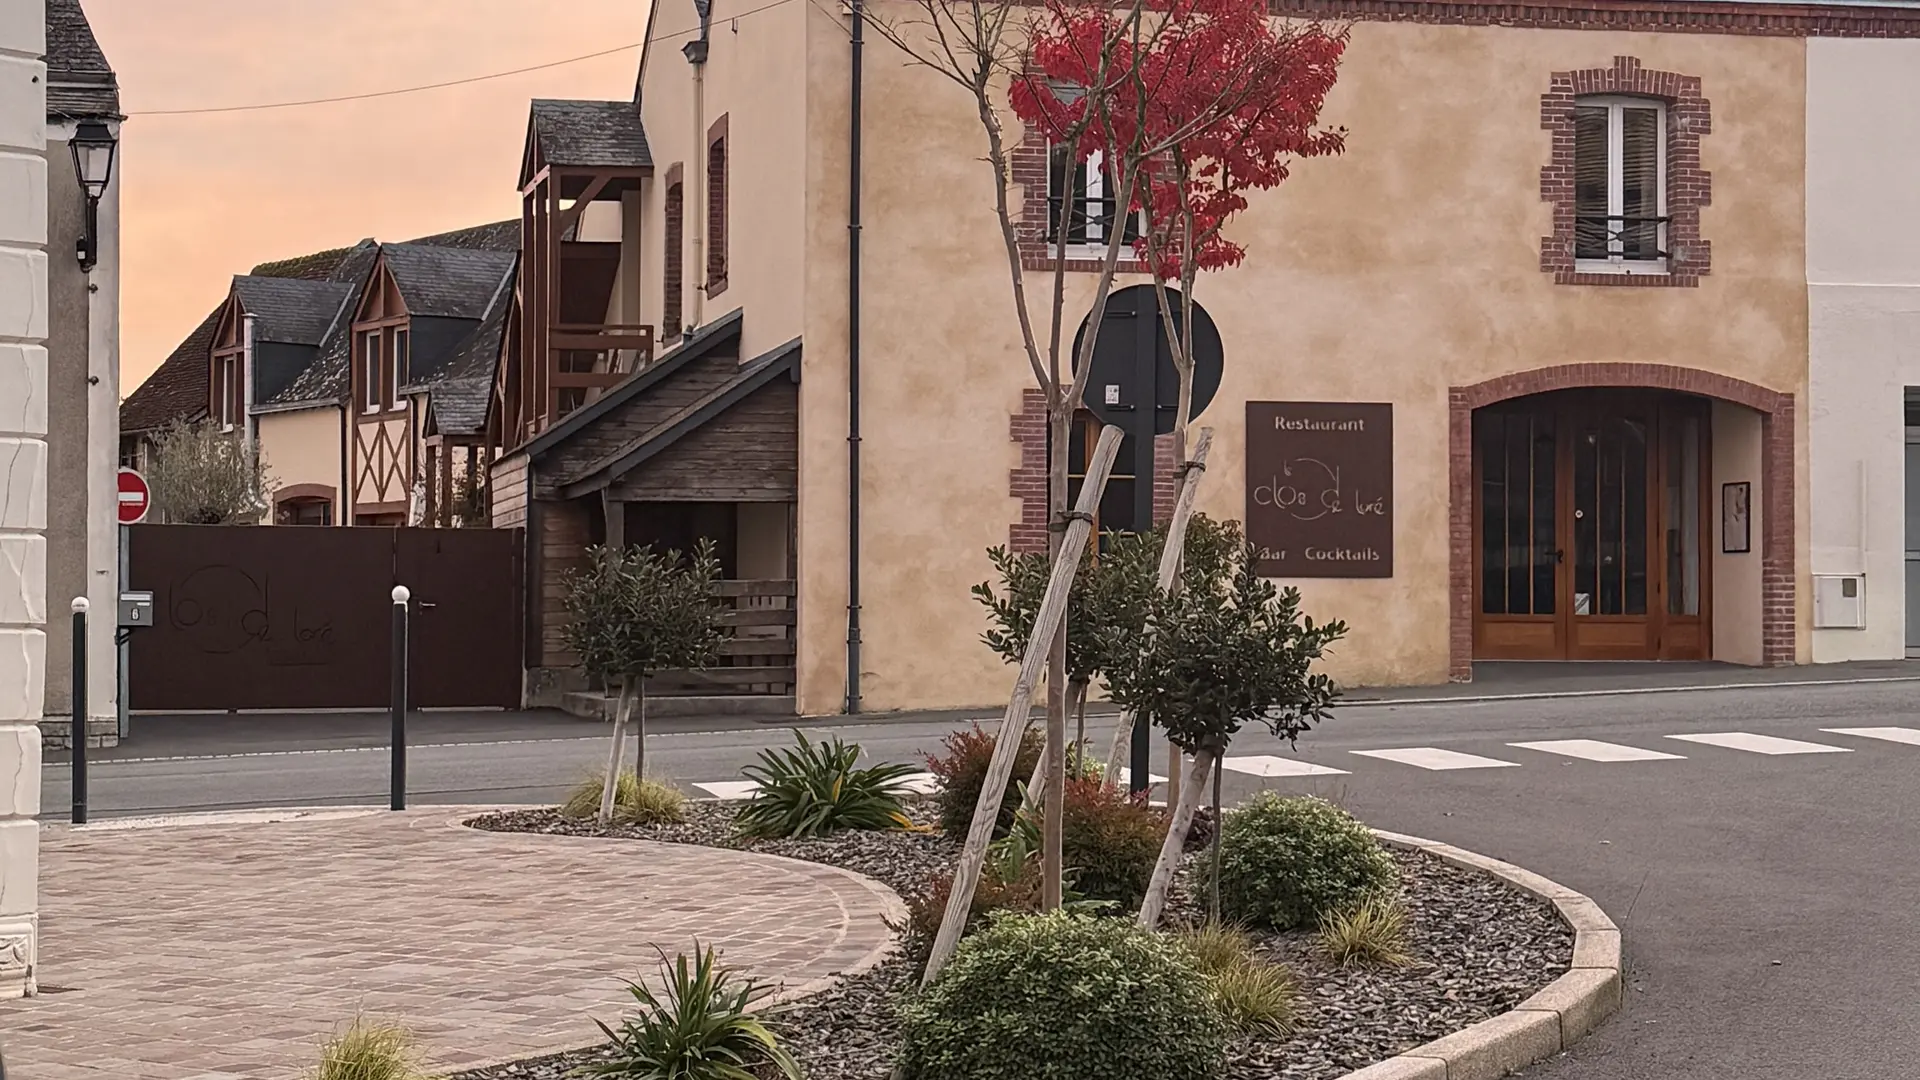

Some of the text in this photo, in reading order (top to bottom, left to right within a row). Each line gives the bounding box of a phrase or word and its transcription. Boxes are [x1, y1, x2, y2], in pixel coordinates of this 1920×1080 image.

[1275, 415, 1365, 432] Restaurant
[1260, 546, 1380, 561] Bar Cocktails
